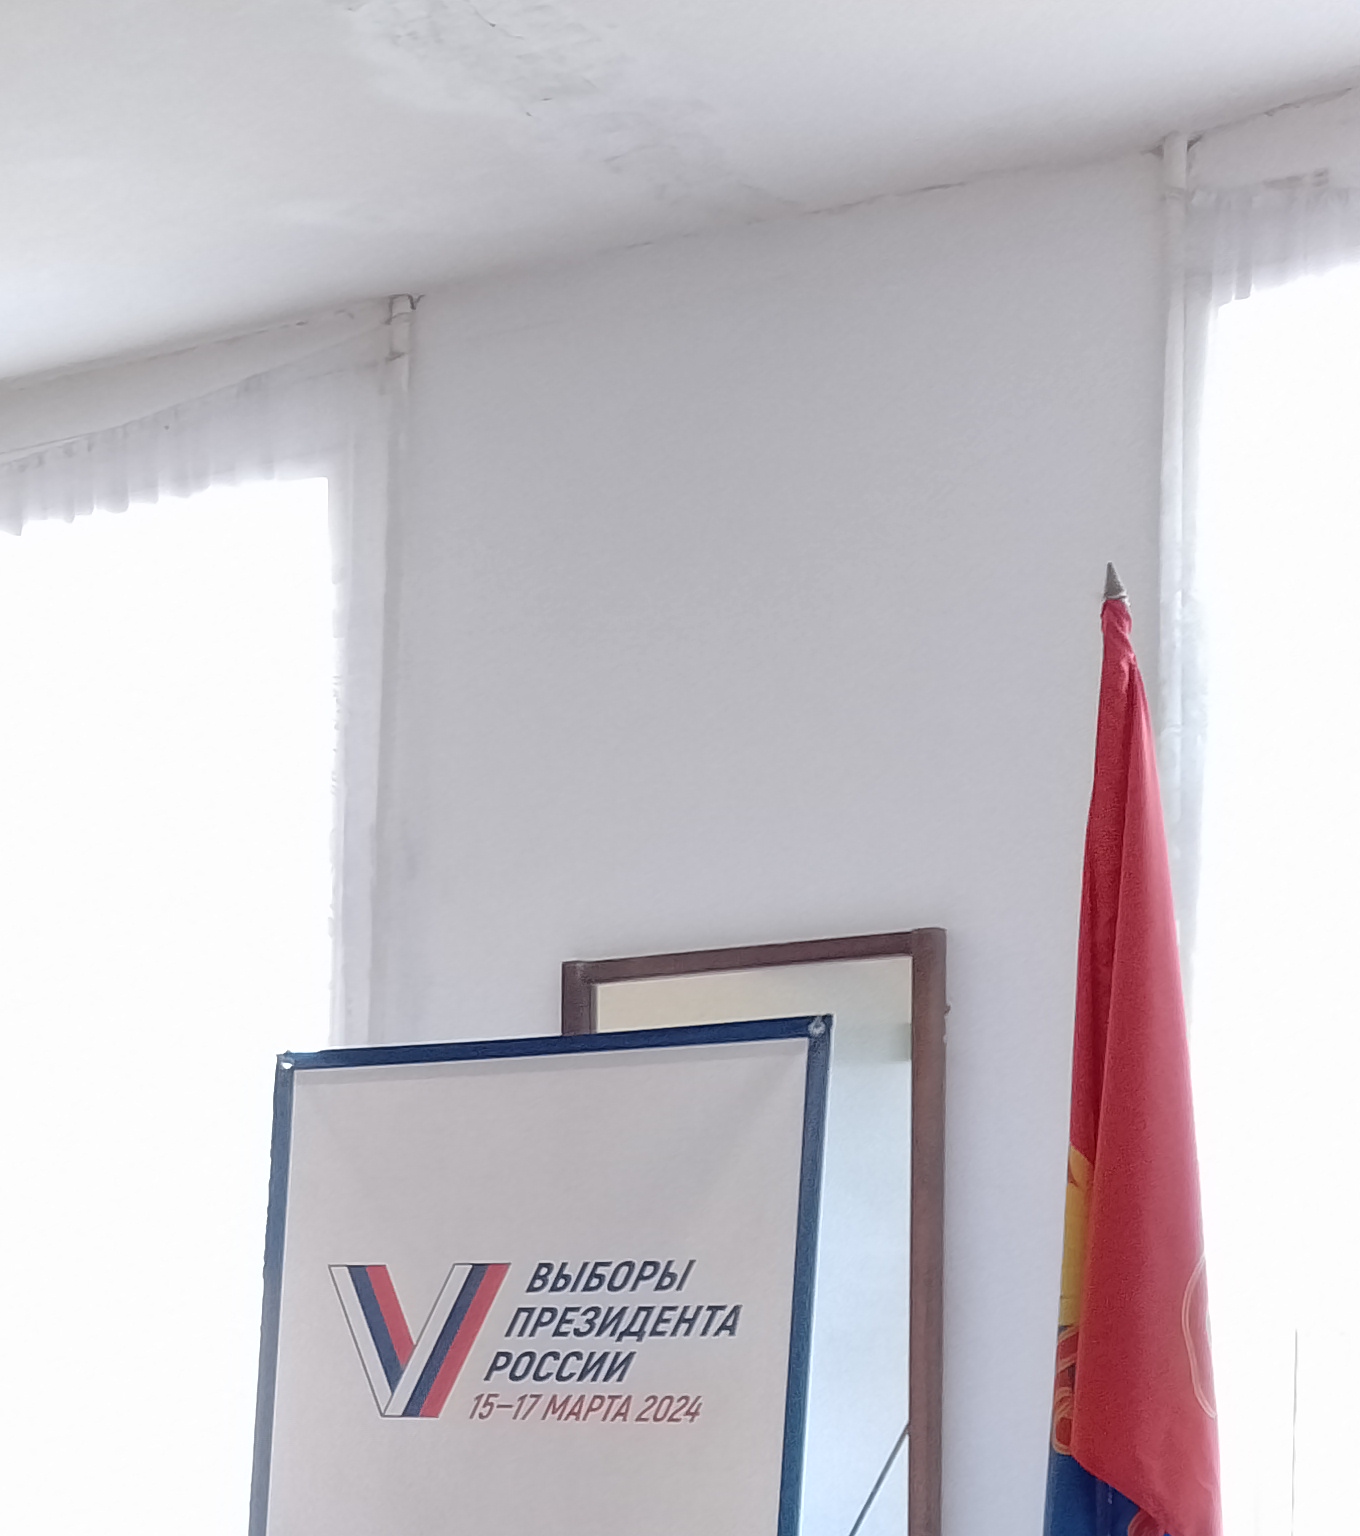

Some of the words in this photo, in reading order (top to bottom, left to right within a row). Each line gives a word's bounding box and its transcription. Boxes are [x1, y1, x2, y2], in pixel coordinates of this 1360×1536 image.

[525, 1259, 697, 1294] ВЫБОРЫ
[503, 1303, 743, 1341] ПРЕЗИДЕНТА
[483, 1350, 637, 1383] РОССИИ
[541, 1394, 630, 1423] МАРТА
[634, 1394, 703, 1423] 2024
